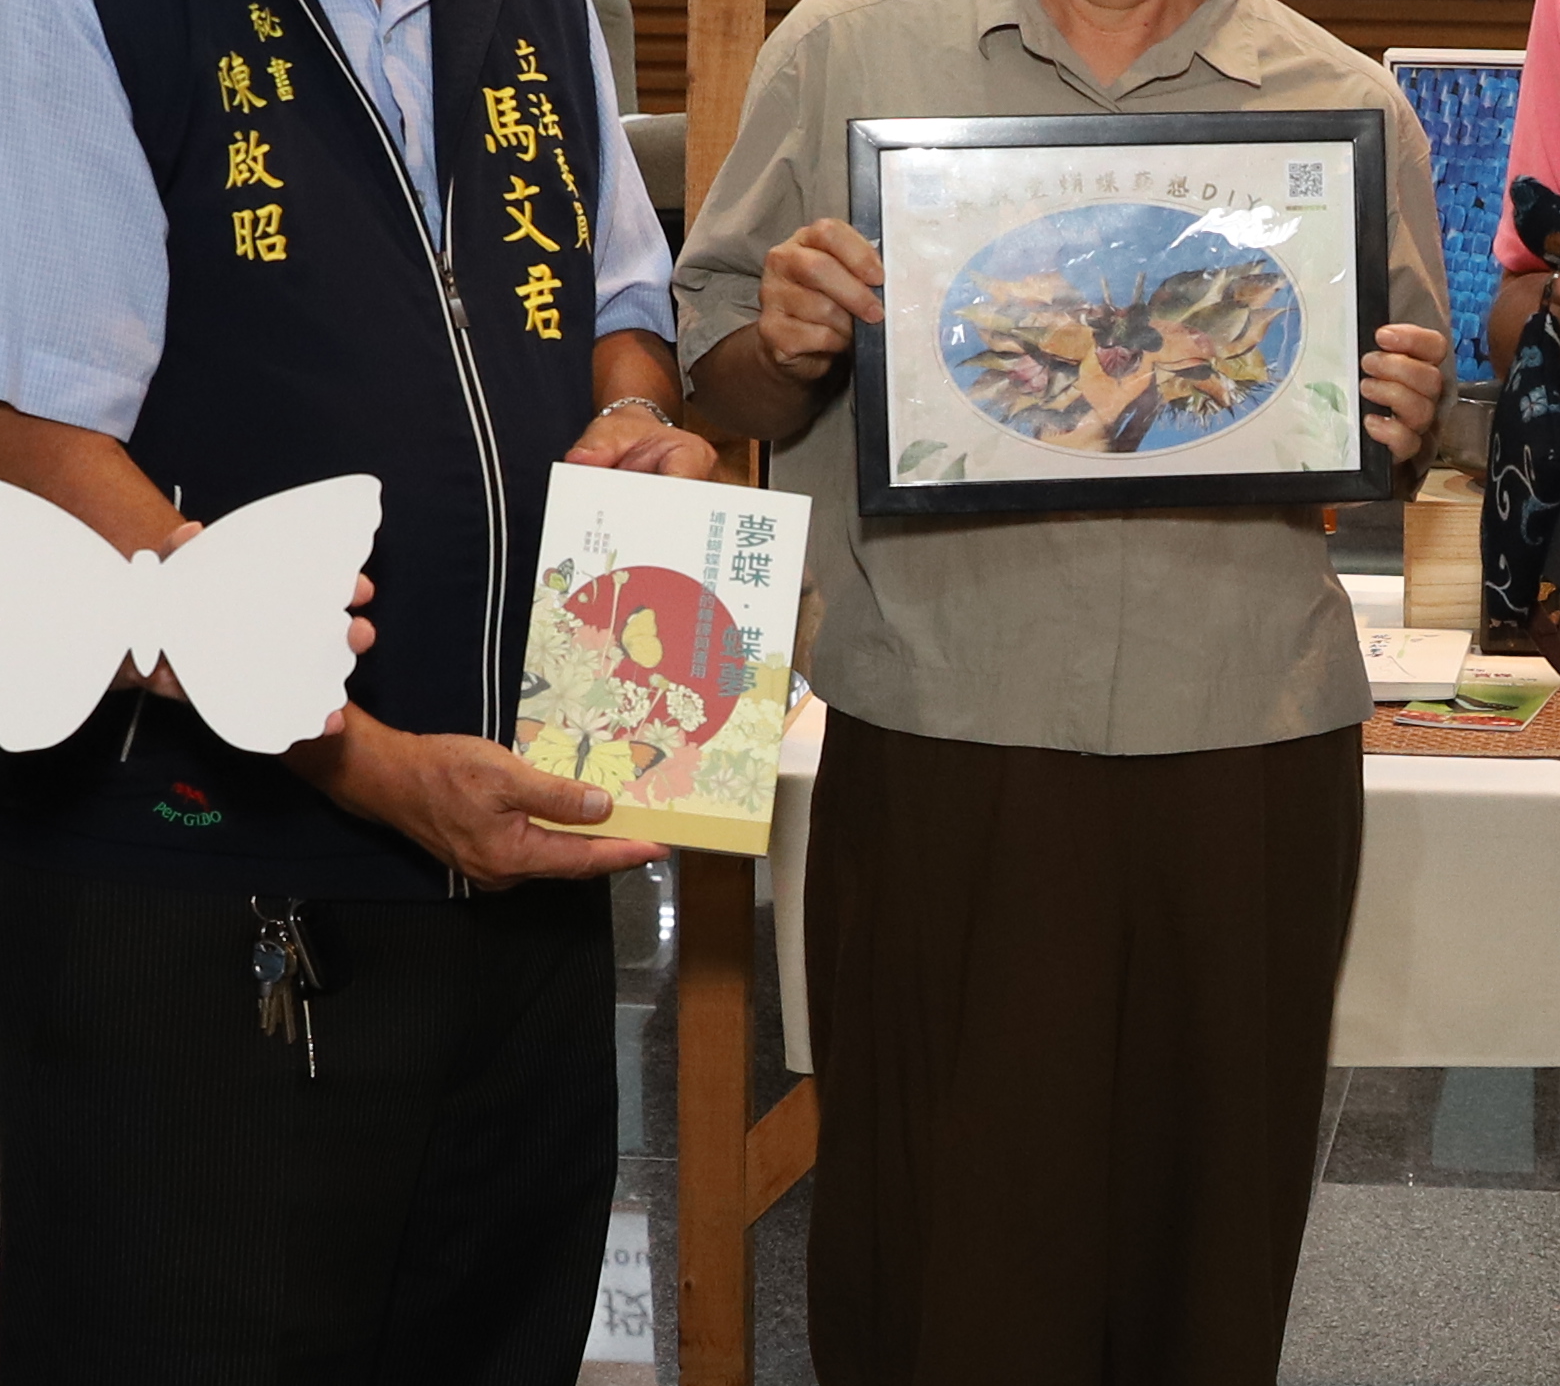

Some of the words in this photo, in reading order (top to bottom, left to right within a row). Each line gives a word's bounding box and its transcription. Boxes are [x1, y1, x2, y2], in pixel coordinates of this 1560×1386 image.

[248, 2, 295, 102] 秘書
[483, 87, 563, 340] 馬文君
